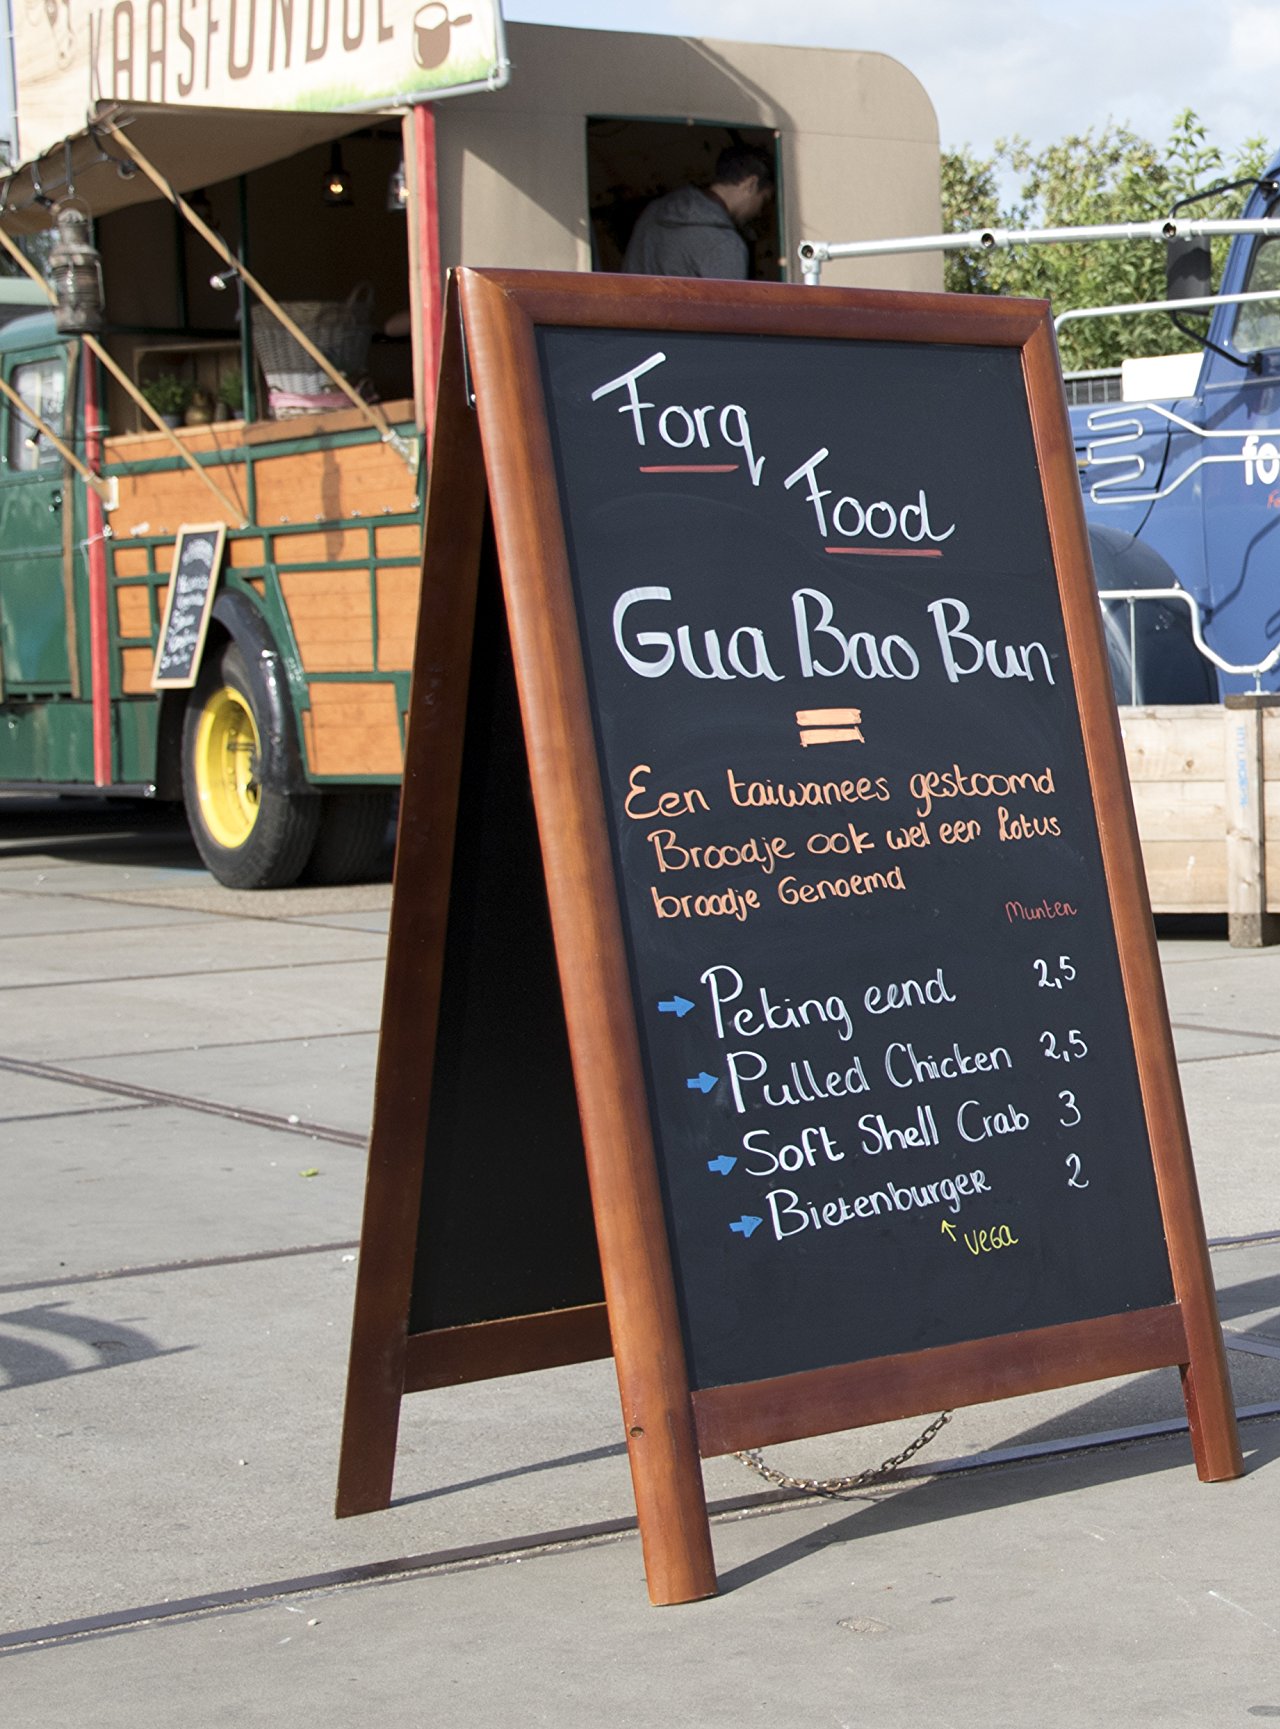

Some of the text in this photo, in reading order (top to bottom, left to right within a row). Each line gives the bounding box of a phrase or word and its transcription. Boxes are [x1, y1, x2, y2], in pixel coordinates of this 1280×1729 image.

[592, 352, 765, 486] Forq
[784, 448, 956, 541] Food
[613, 586, 1055, 685] Gua Bao Bun
[624, 764, 1056, 820] Een taiwanees gestoomd
[647, 829, 796, 874] Broodje
[806, 823, 876, 855] ook
[886, 821, 931, 850] wel
[939, 819, 981, 844] een
[778, 866, 907, 905] Genoemd
[1005, 899, 1078, 923] Munten
[700, 956, 1077, 1041] Peking eend 2,5
[727, 1029, 1089, 1114] Pulled Chicken 2,5
[742, 1090, 1081, 1176] Soft Shell Crab 3
[1065, 1153, 1089, 1189] 2
